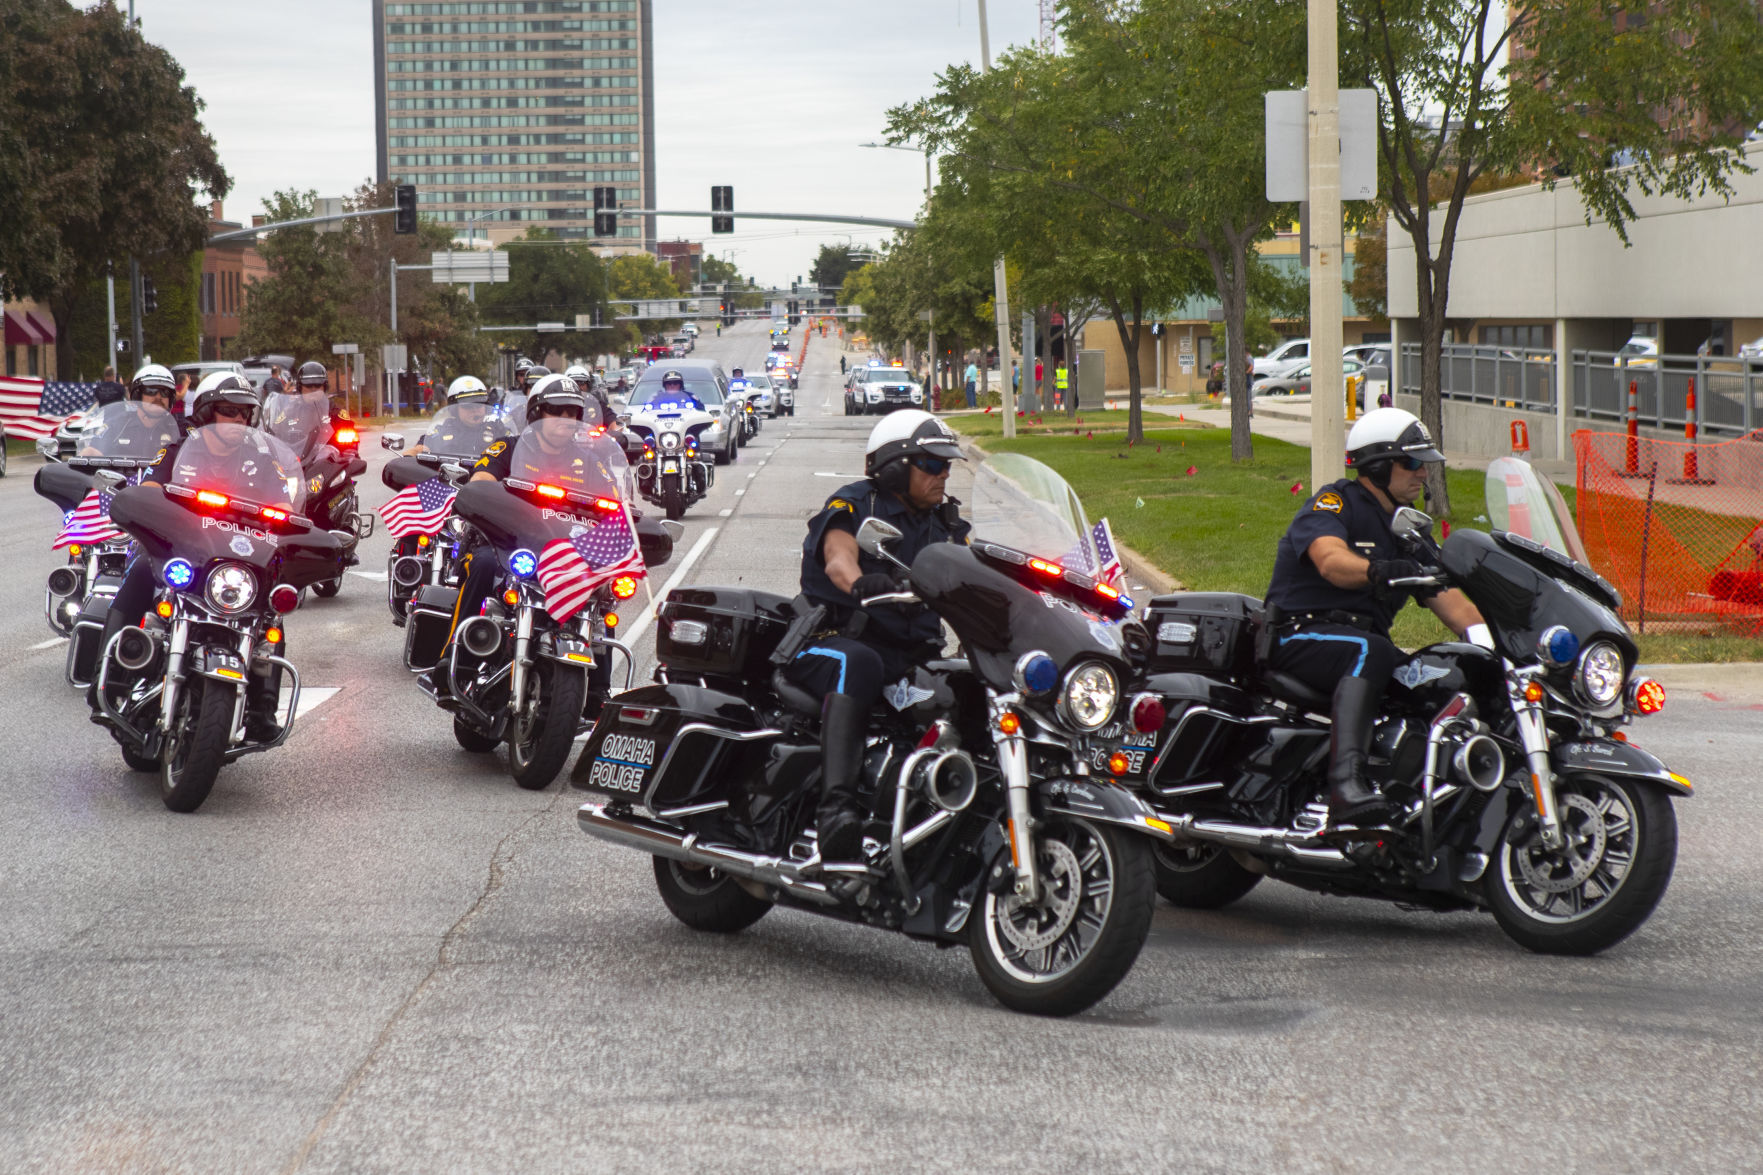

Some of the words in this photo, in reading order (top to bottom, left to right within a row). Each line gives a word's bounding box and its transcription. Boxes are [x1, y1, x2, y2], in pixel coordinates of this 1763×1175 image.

[542, 508, 600, 529] POLIC
[202, 516, 278, 548] POLICE
[566, 640, 586, 653] 17
[218, 654, 240, 669] 15
[601, 733, 656, 765] OMAHA
[588, 760, 645, 793] POLICE
